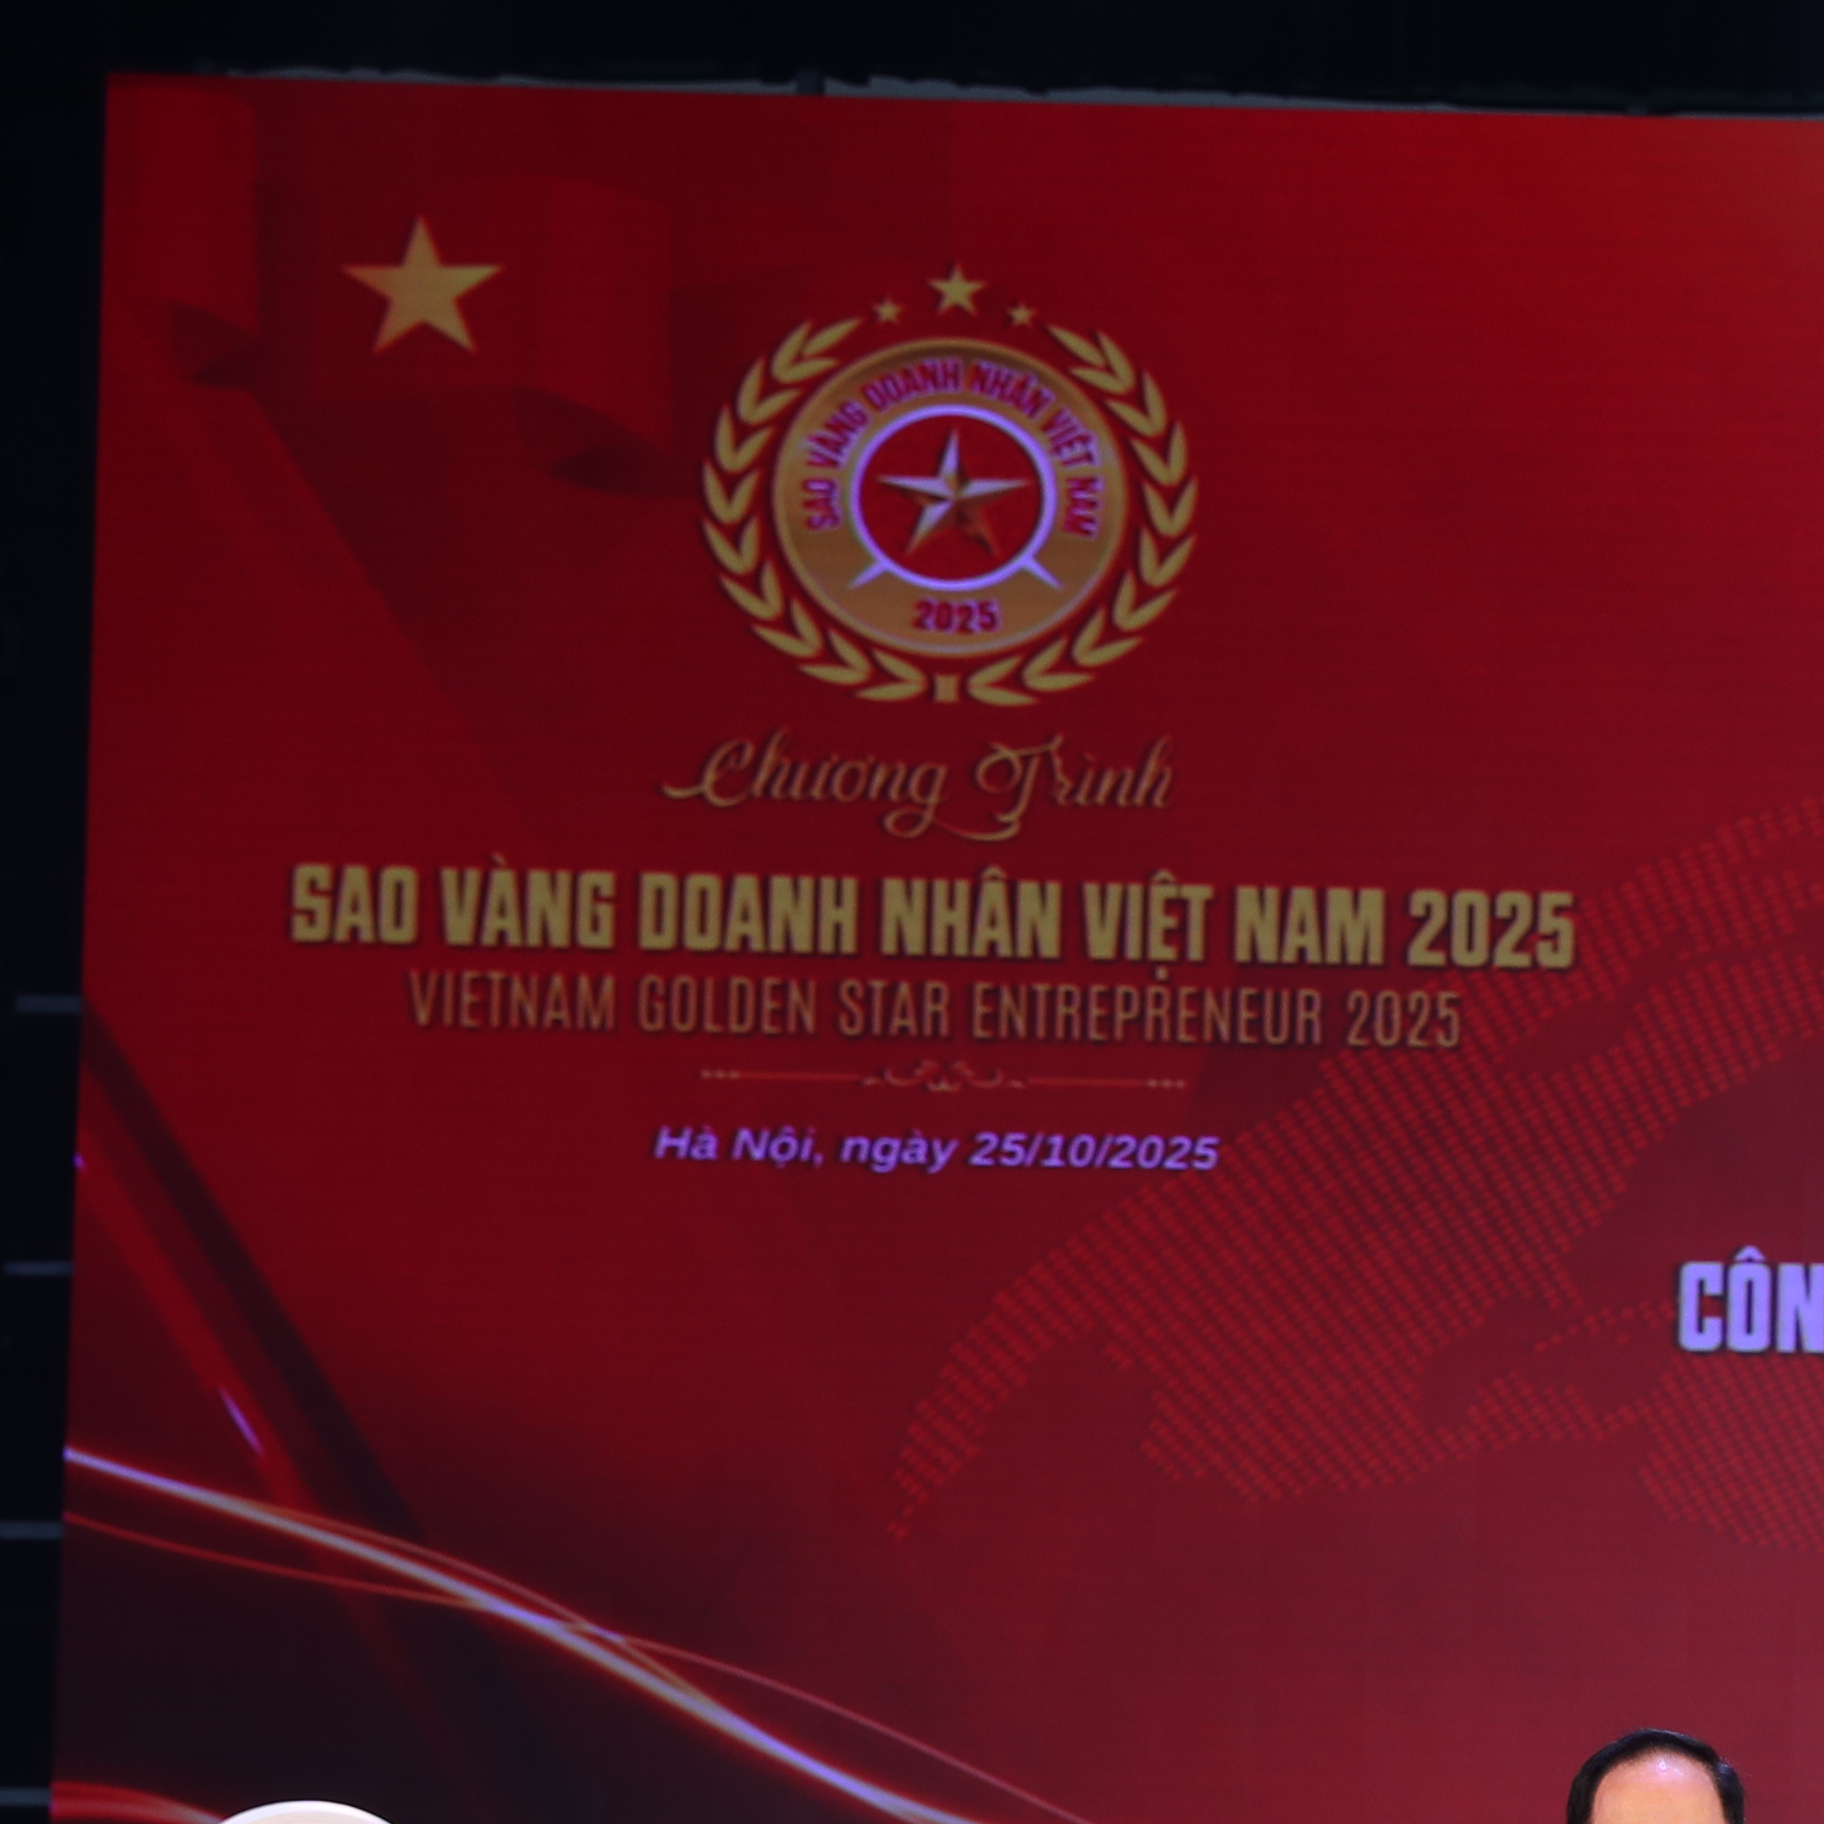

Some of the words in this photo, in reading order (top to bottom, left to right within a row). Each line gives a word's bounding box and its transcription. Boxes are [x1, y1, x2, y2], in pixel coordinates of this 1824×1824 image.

[912, 598, 1001, 635] 2025
[663, 727, 948, 840] Chương
[974, 734, 1173, 841] Trình
[293, 864, 417, 943] SAO
[441, 854, 614, 948] VÀNG
[640, 873, 857, 953] DOANH
[882, 865, 1061, 958] NHÂN
[1084, 869, 1213, 979] VIỆT
[1236, 886, 1384, 964] NAM
[1408, 889, 1574, 968] 2025
[412, 971, 614, 1029] VIETNAM
[639, 975, 815, 1034] GOLDEN
[840, 979, 948, 1035] STAR
[973, 982, 1321, 1044] ENTREPRENEUR
[1348, 990, 1459, 1047] 2025
[655, 1126, 719, 1160] Hà
[733, 1125, 824, 1167] Nội,
[841, 1132, 958, 1173] ngày
[970, 1131, 1219, 1171] 25/10/2025
